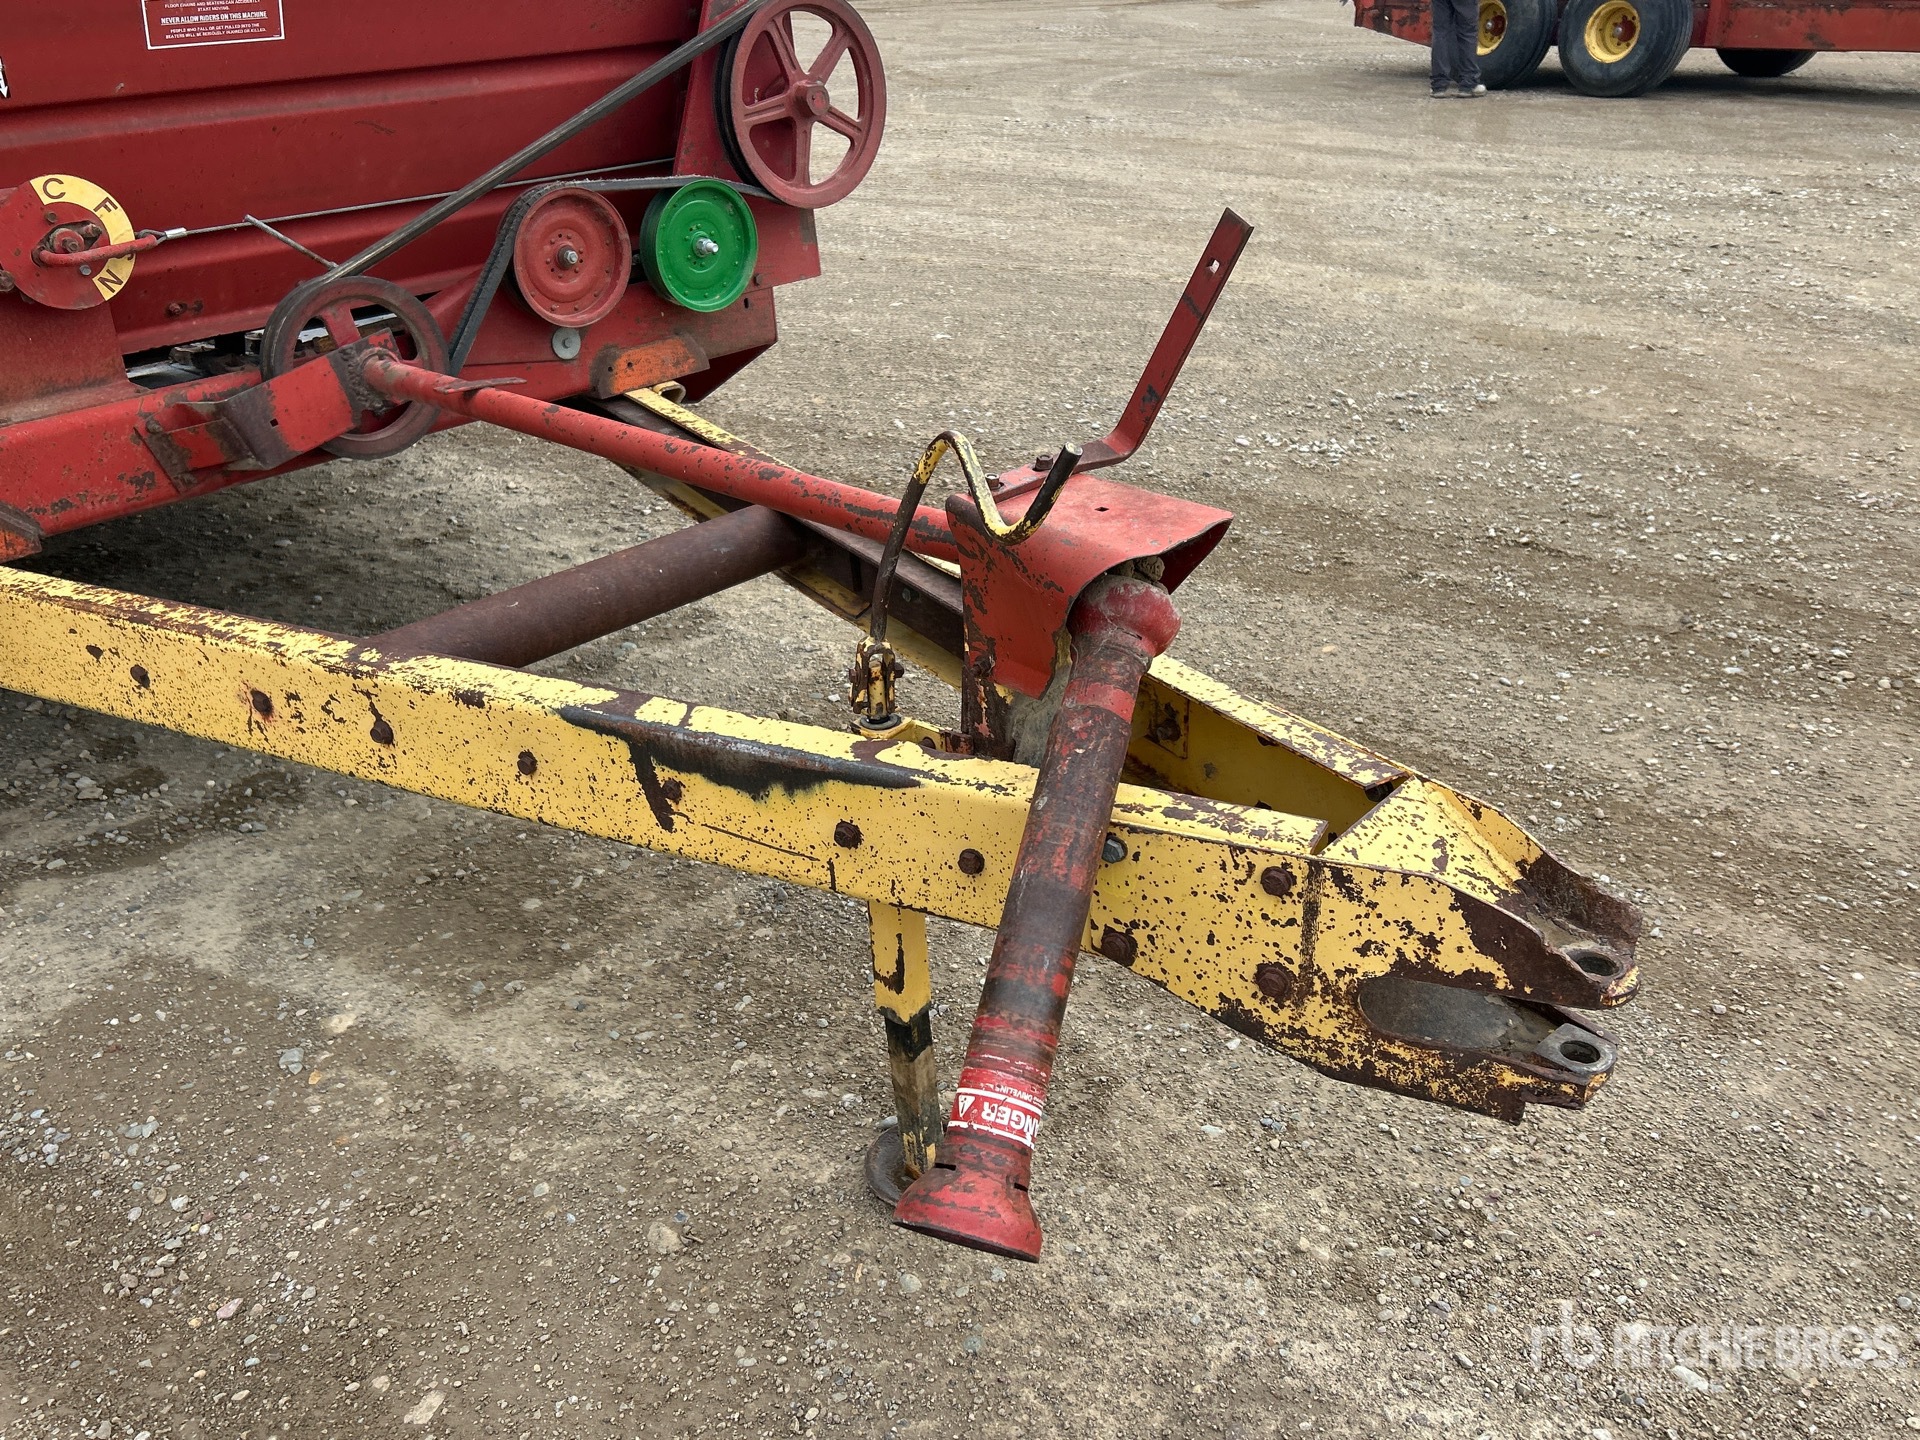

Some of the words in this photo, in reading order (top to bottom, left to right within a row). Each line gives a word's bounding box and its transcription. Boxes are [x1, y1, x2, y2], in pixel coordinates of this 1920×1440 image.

[42, 178, 66, 200] C
[92, 196, 118, 213] F
[98, 268, 124, 294] N
